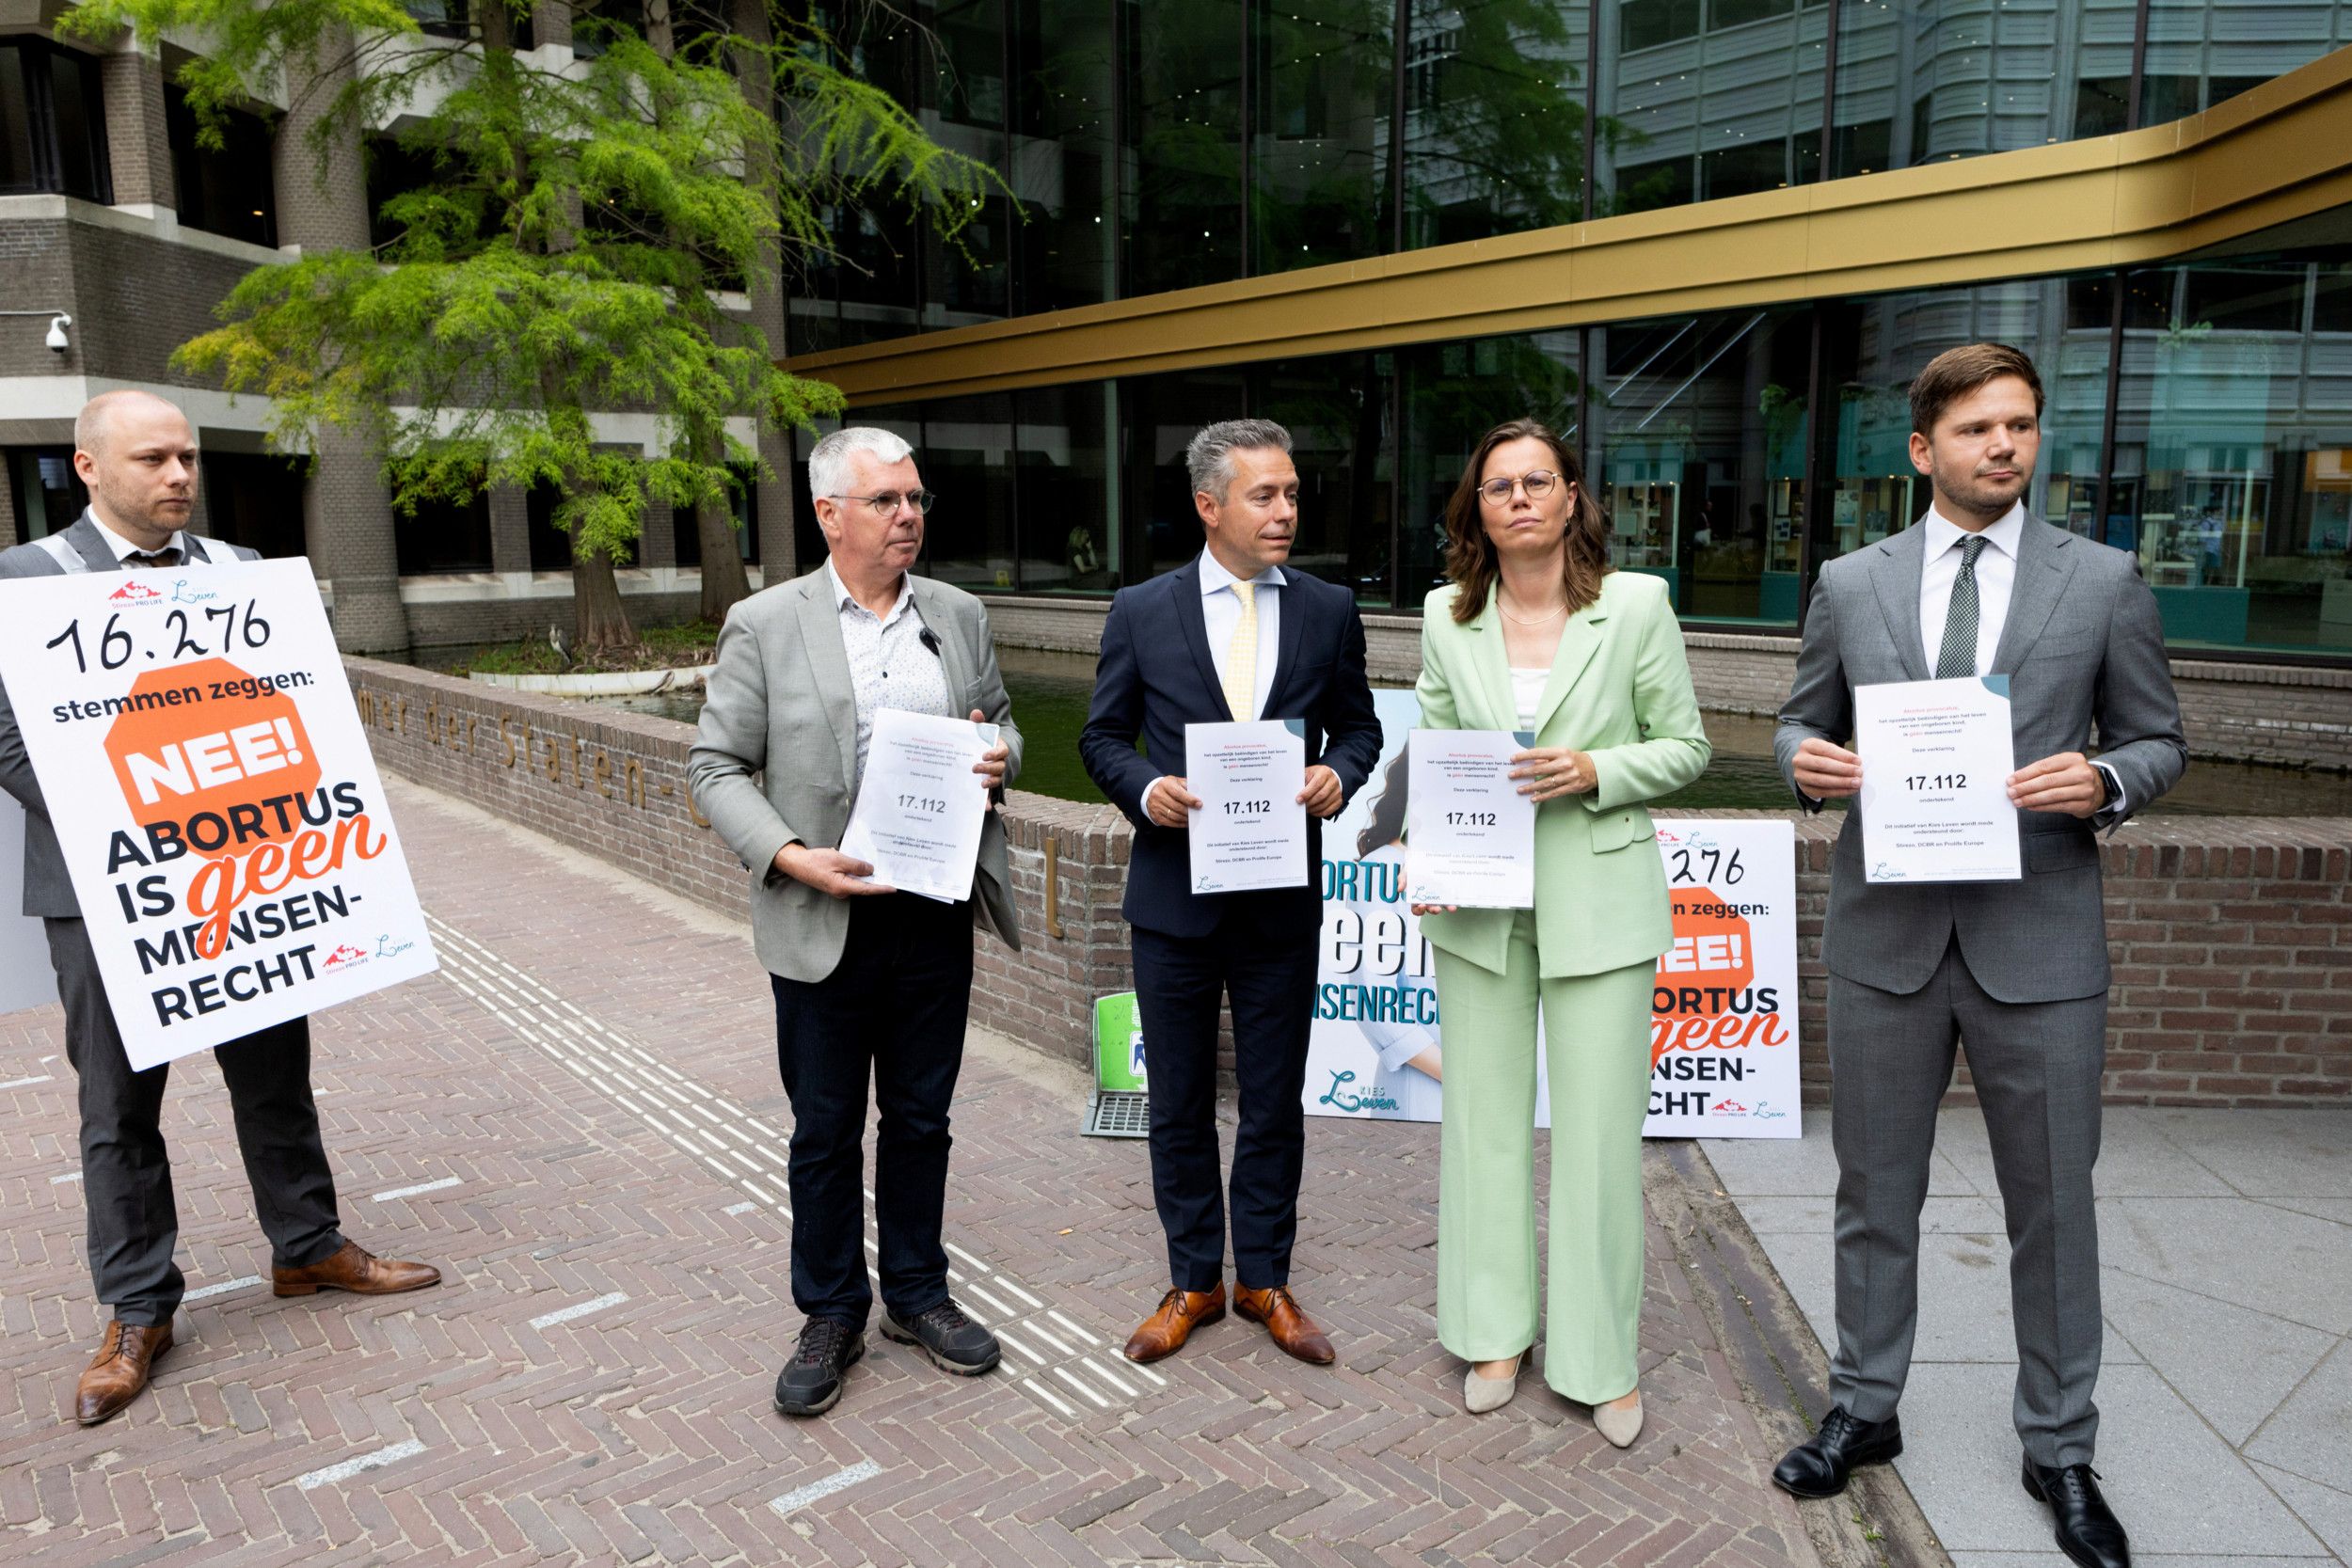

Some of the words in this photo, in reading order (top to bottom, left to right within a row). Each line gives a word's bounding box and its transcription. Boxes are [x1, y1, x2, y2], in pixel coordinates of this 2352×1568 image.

[171, 579, 218, 604] Leven
[46, 598, 271, 673] 16.276
[53, 685, 202, 723] stemmen
[210, 670, 315, 704] zeggen:
[358, 689, 407, 736] mer
[426, 691, 476, 755] der
[124, 716, 303, 806] NEE!
[1905, 773, 1967, 791] 17.112
[898, 794, 946, 814] 17.112
[1224, 800, 1271, 815] 17.112
[1446, 812, 1497, 827] 17.112
[106, 781, 365, 875] ABORTUS
[114, 875, 176, 925] IS
[186, 813, 388, 959] geen
[1321, 860, 1406, 903] ORTU
[1672, 847, 1744, 885] 276
[134, 883, 363, 976] MENSEN-
[1692, 903, 1770, 919] zeggen:
[1656, 934, 1743, 974] EE!
[151, 943, 317, 1027] RECHT
[1312, 983, 1439, 1025] SENREC
[1652, 987, 1779, 1015] ORTUS
[1651, 1056, 1756, 1082] NSEN-
[1319, 1069, 1399, 1113] Leven
[1360, 1085, 1386, 1097] KIES
[1647, 1091, 1711, 1117] CHT
